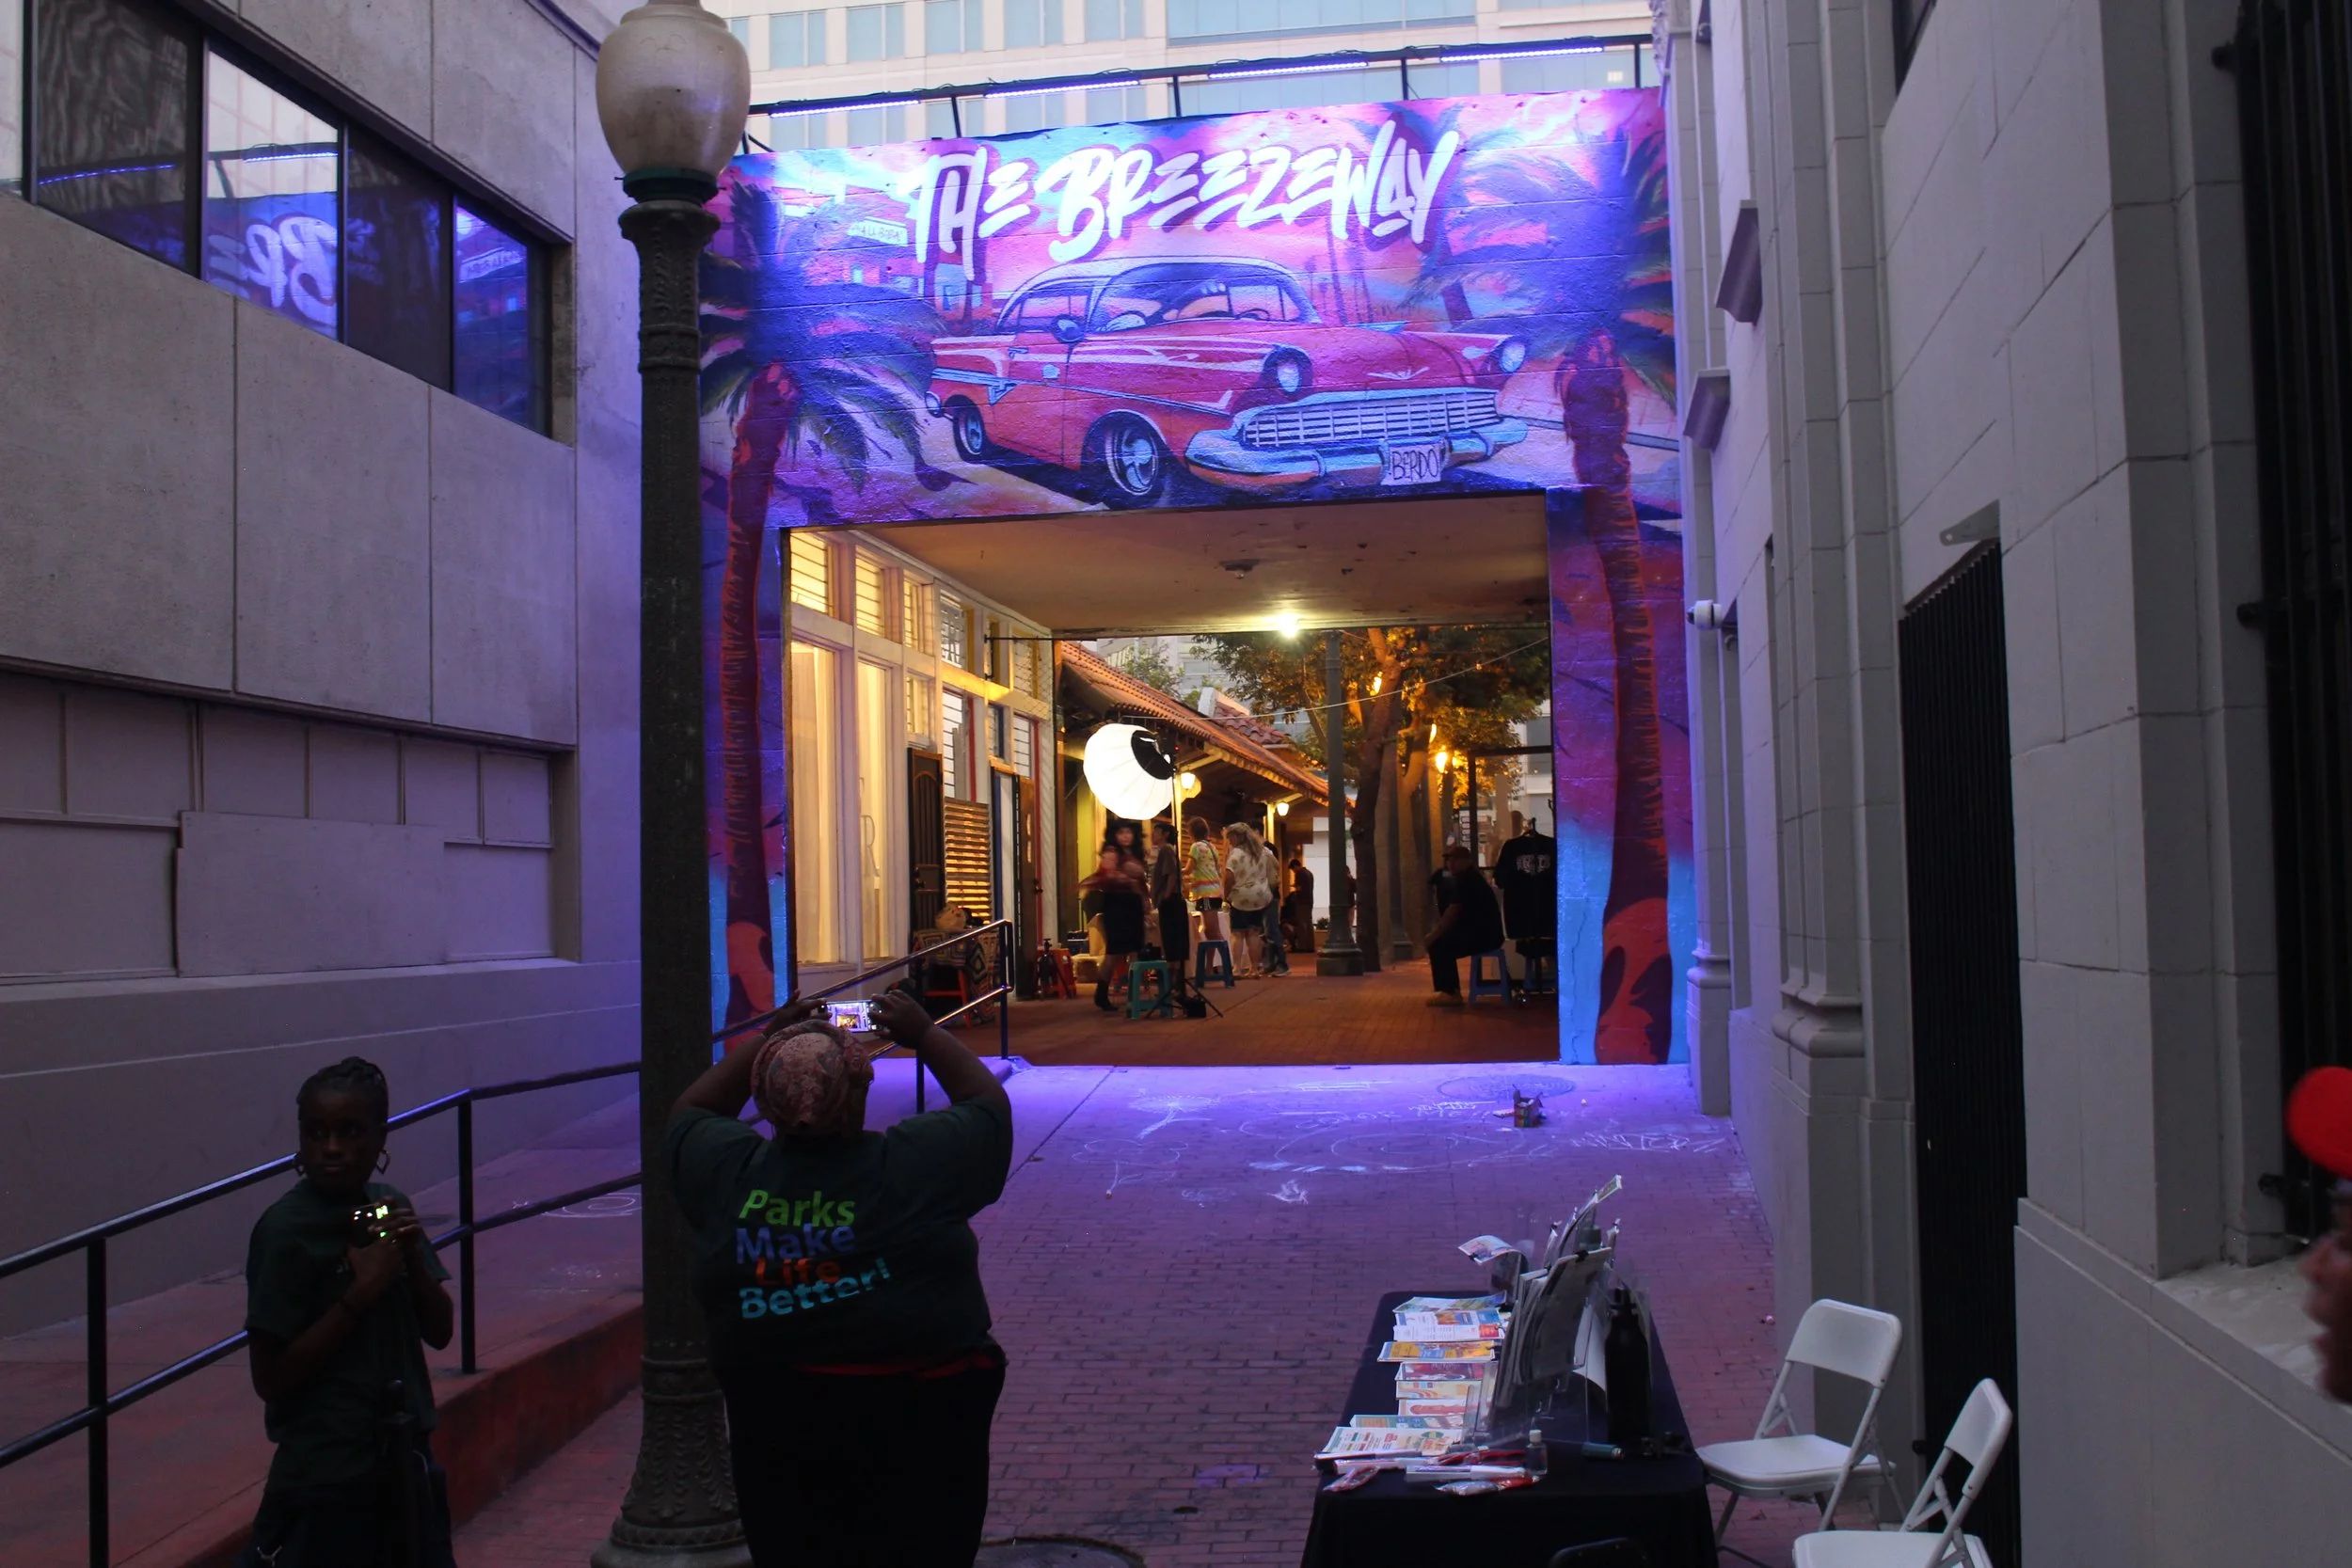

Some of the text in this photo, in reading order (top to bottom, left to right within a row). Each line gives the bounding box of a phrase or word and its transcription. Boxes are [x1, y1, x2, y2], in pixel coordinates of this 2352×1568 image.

[897, 119, 1459, 281] THE BREEZEWAY
[1391, 449, 1439, 481] BERDO
[739, 1189, 856, 1227] Parks
[736, 1223, 856, 1264] Make
[739, 1257, 892, 1319] Better!
[755, 1258, 842, 1286] Life
